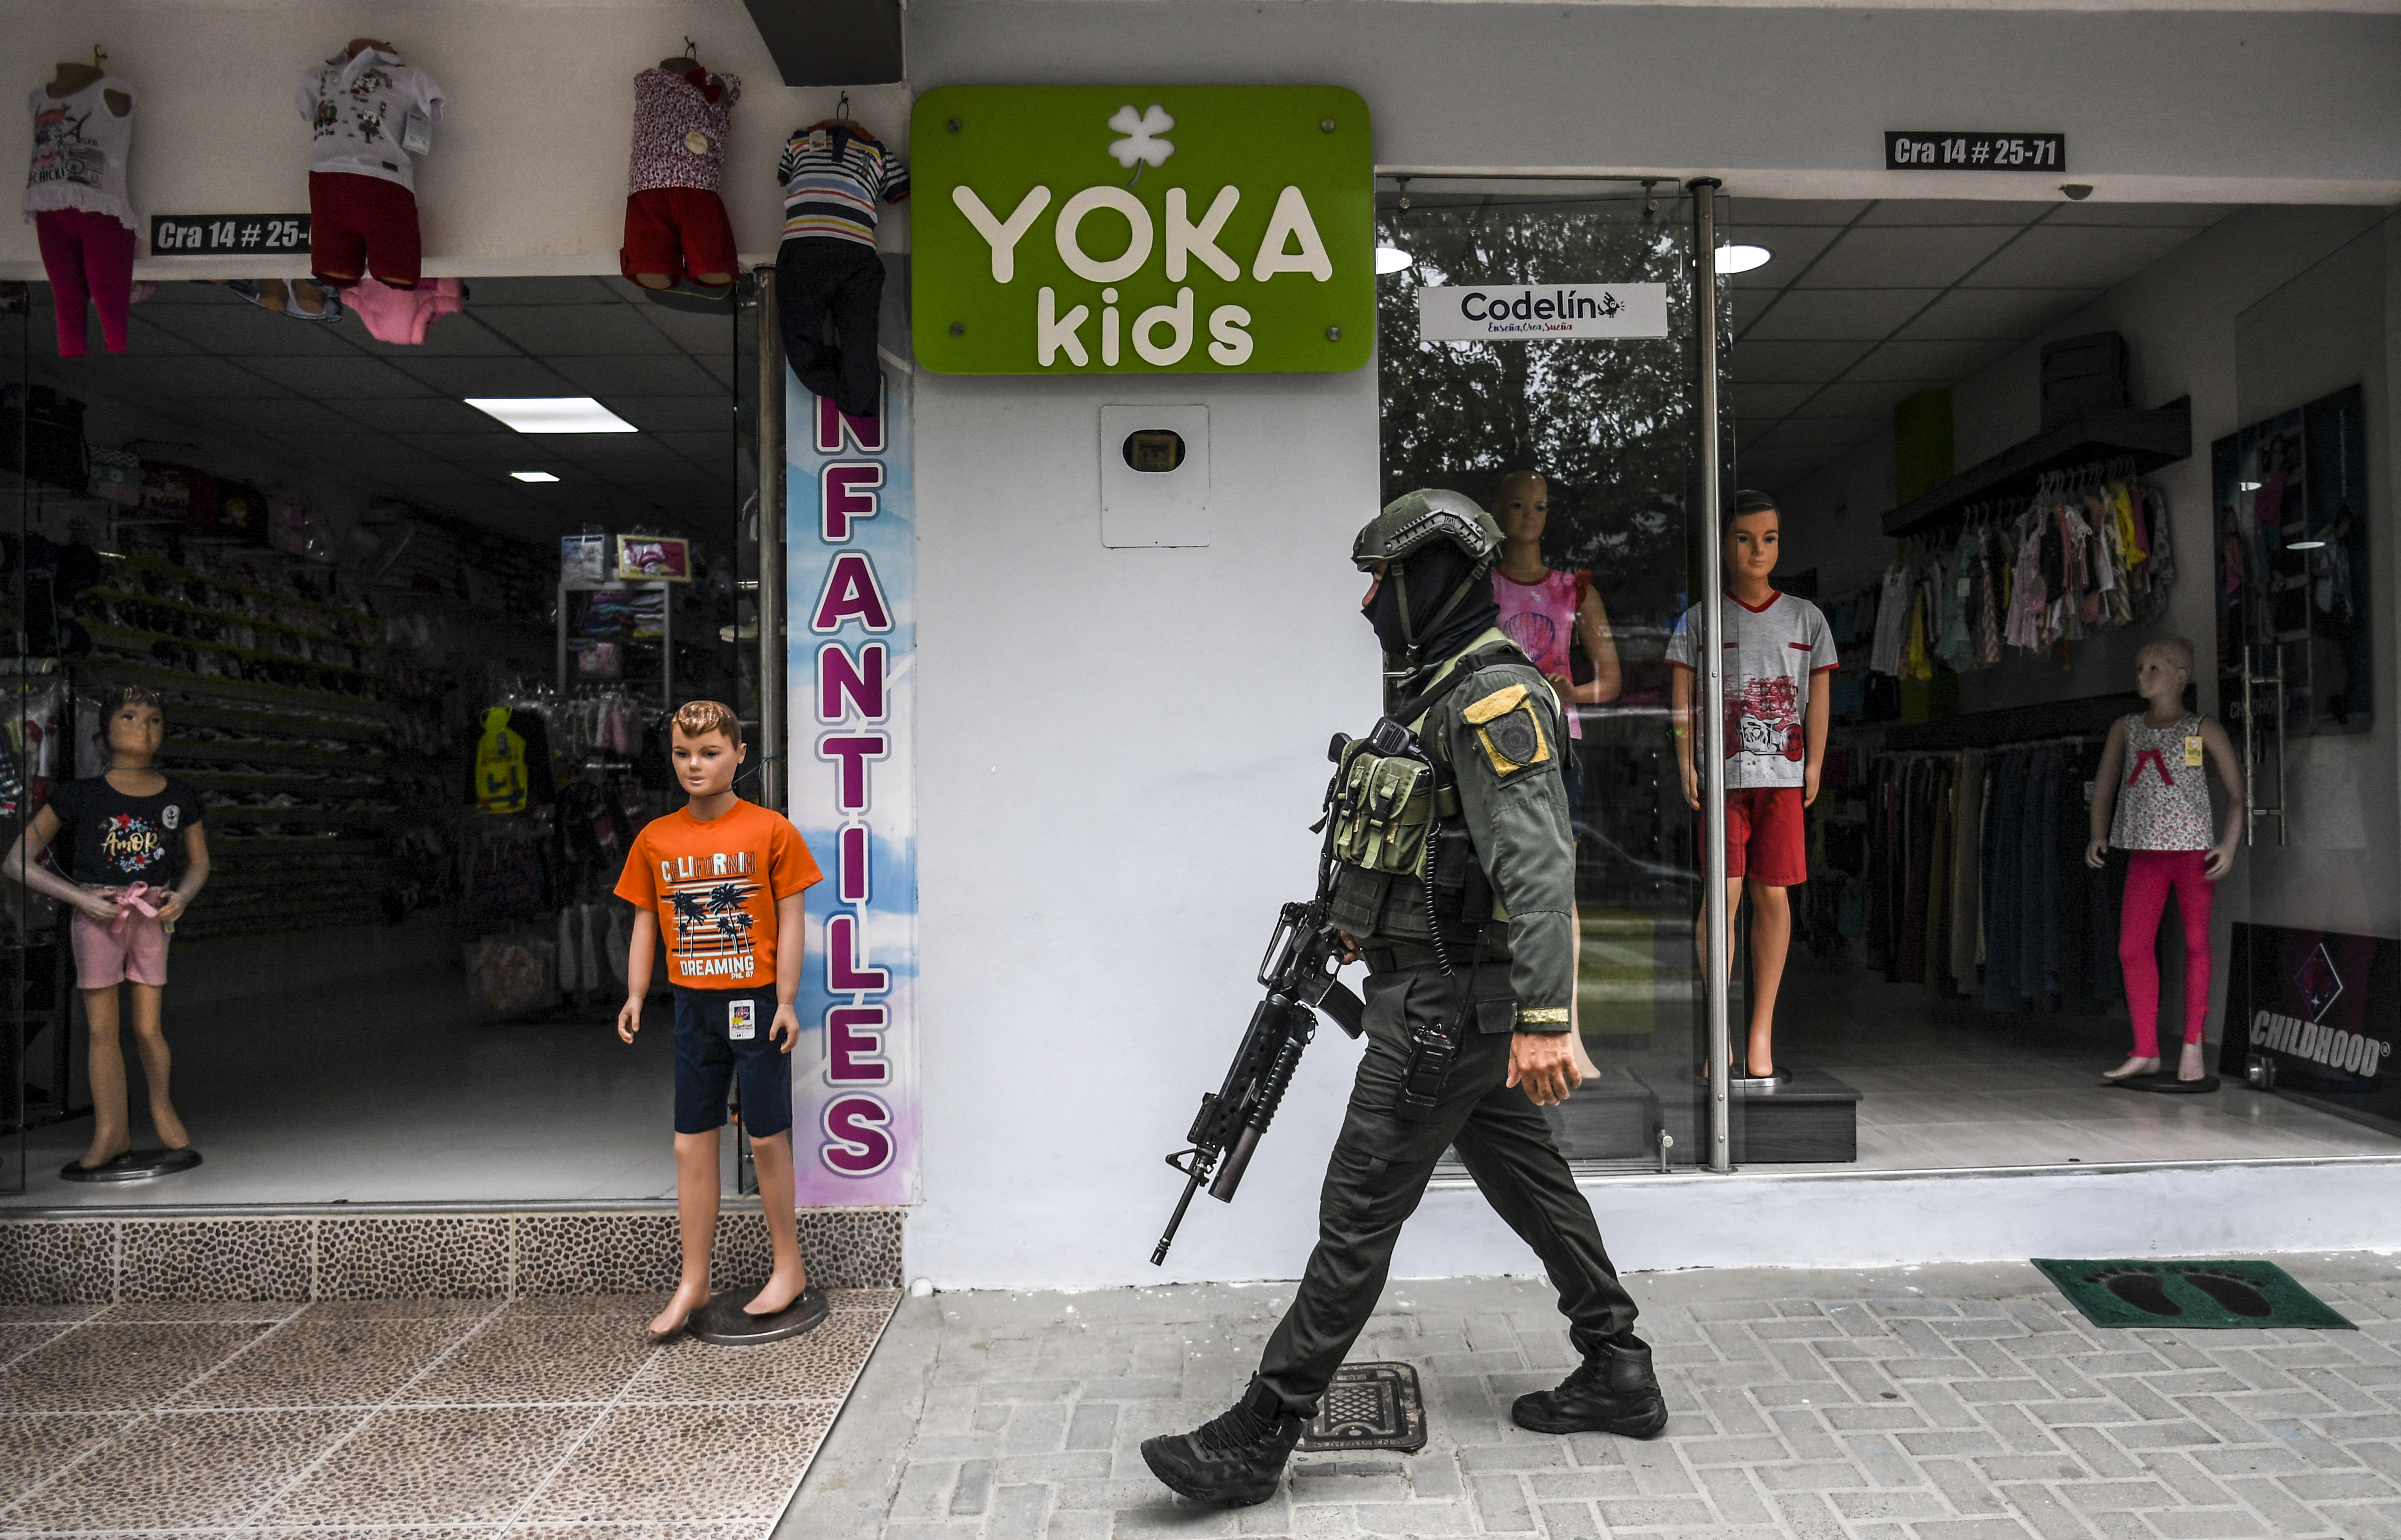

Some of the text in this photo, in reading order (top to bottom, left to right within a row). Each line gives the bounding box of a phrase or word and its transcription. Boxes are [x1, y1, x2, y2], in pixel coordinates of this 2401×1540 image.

[1894, 138, 2056, 165] Cra 14 # 25-71
[158, 221, 312, 248] Cra 14 # 25-
[953, 185, 1333, 283] YOKA
[1460, 290, 1596, 321] Codelín
[1037, 286, 1253, 367] kids
[809, 373, 895, 1176] NFANTILES
[661, 851, 757, 882] CALIFORNIA
[680, 955, 754, 976] DREAMING
